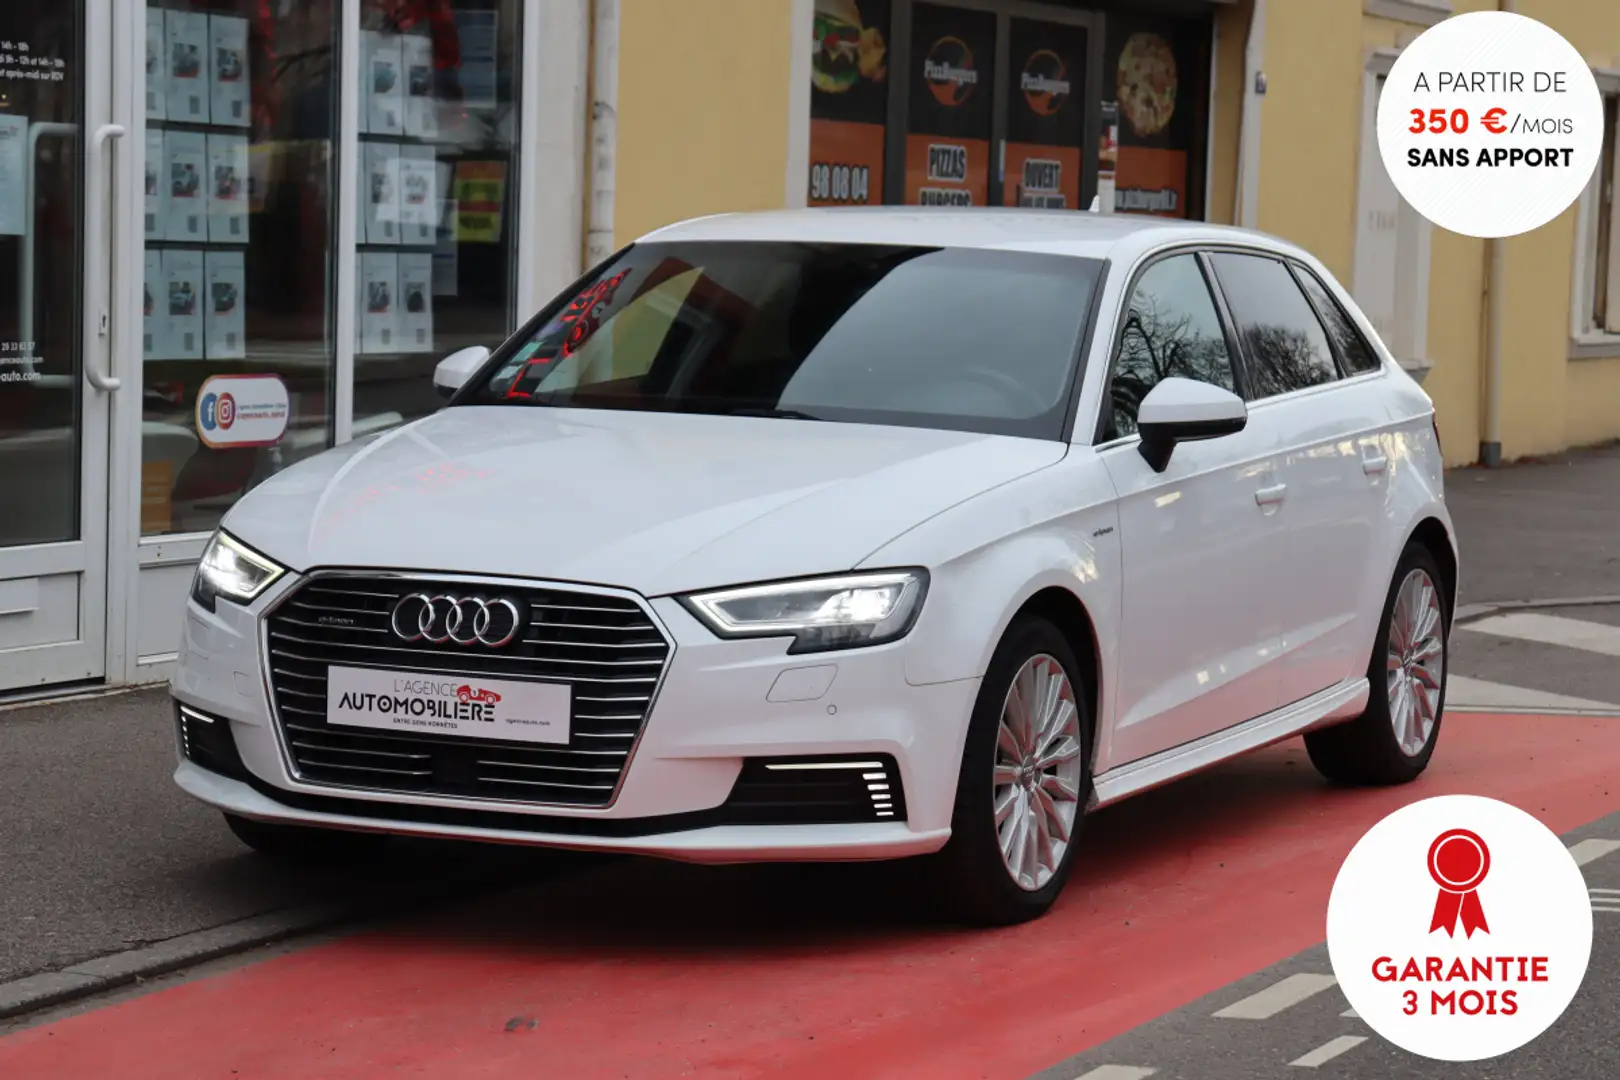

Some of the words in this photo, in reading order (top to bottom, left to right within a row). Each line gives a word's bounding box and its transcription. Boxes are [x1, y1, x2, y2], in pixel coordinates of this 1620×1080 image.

[930, 147, 966, 180] PIZZAS
[1025, 160, 1060, 189] OUVERT
[811, 164, 829, 199] 98
[832, 165, 849, 200] 08
[851, 166, 868, 201] 04
[394, 679, 457, 698] L'AGENCE
